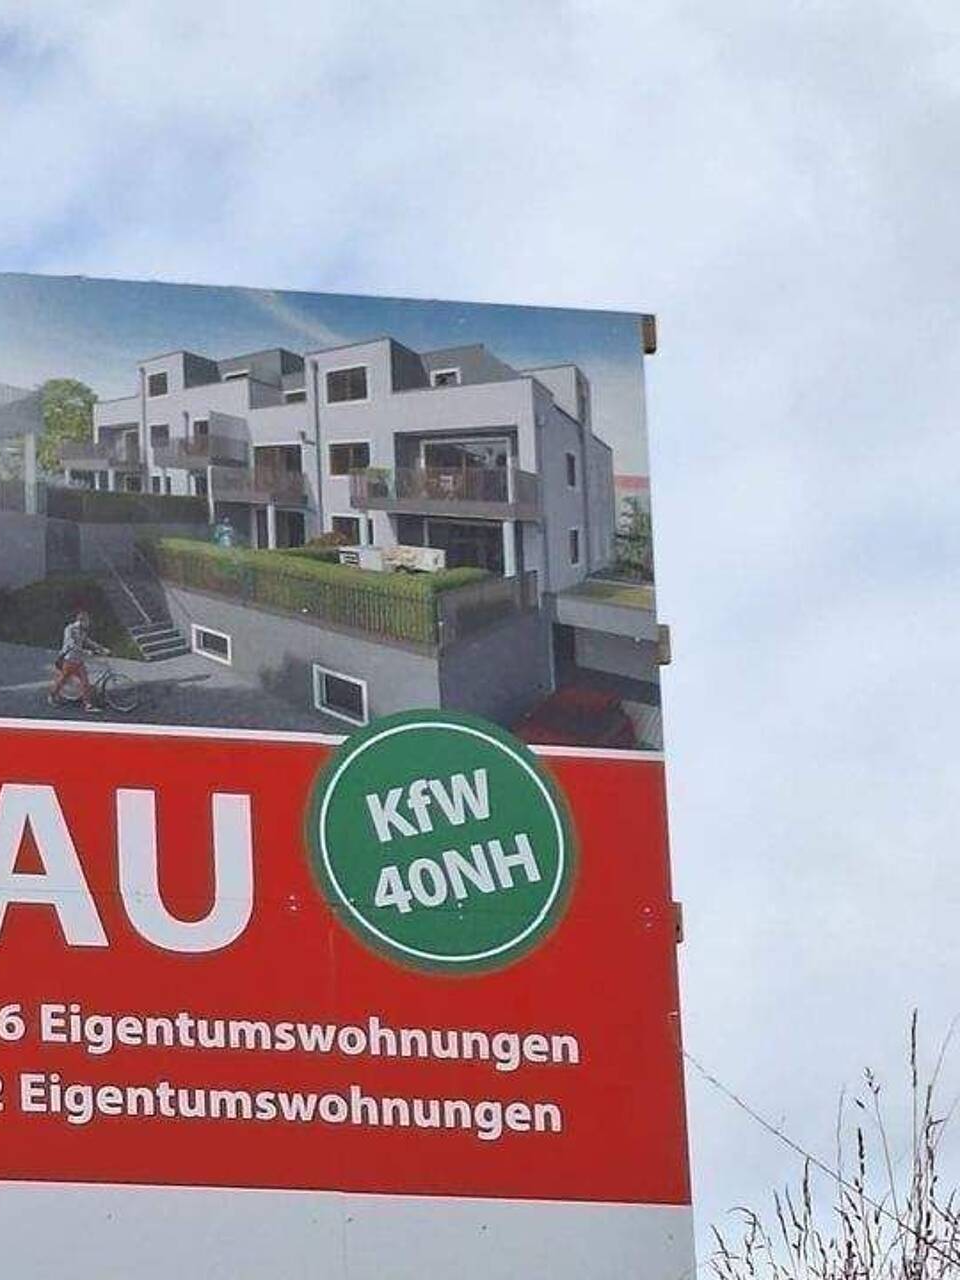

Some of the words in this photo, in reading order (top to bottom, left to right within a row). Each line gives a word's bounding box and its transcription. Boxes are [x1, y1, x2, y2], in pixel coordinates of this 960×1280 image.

[366, 769, 491, 842] KfW
[372, 832, 541, 914] 40NH
[41, 1004, 580, 1072] Eigentumswohnungen
[20, 1073, 562, 1141] Eigentumswohnungen
